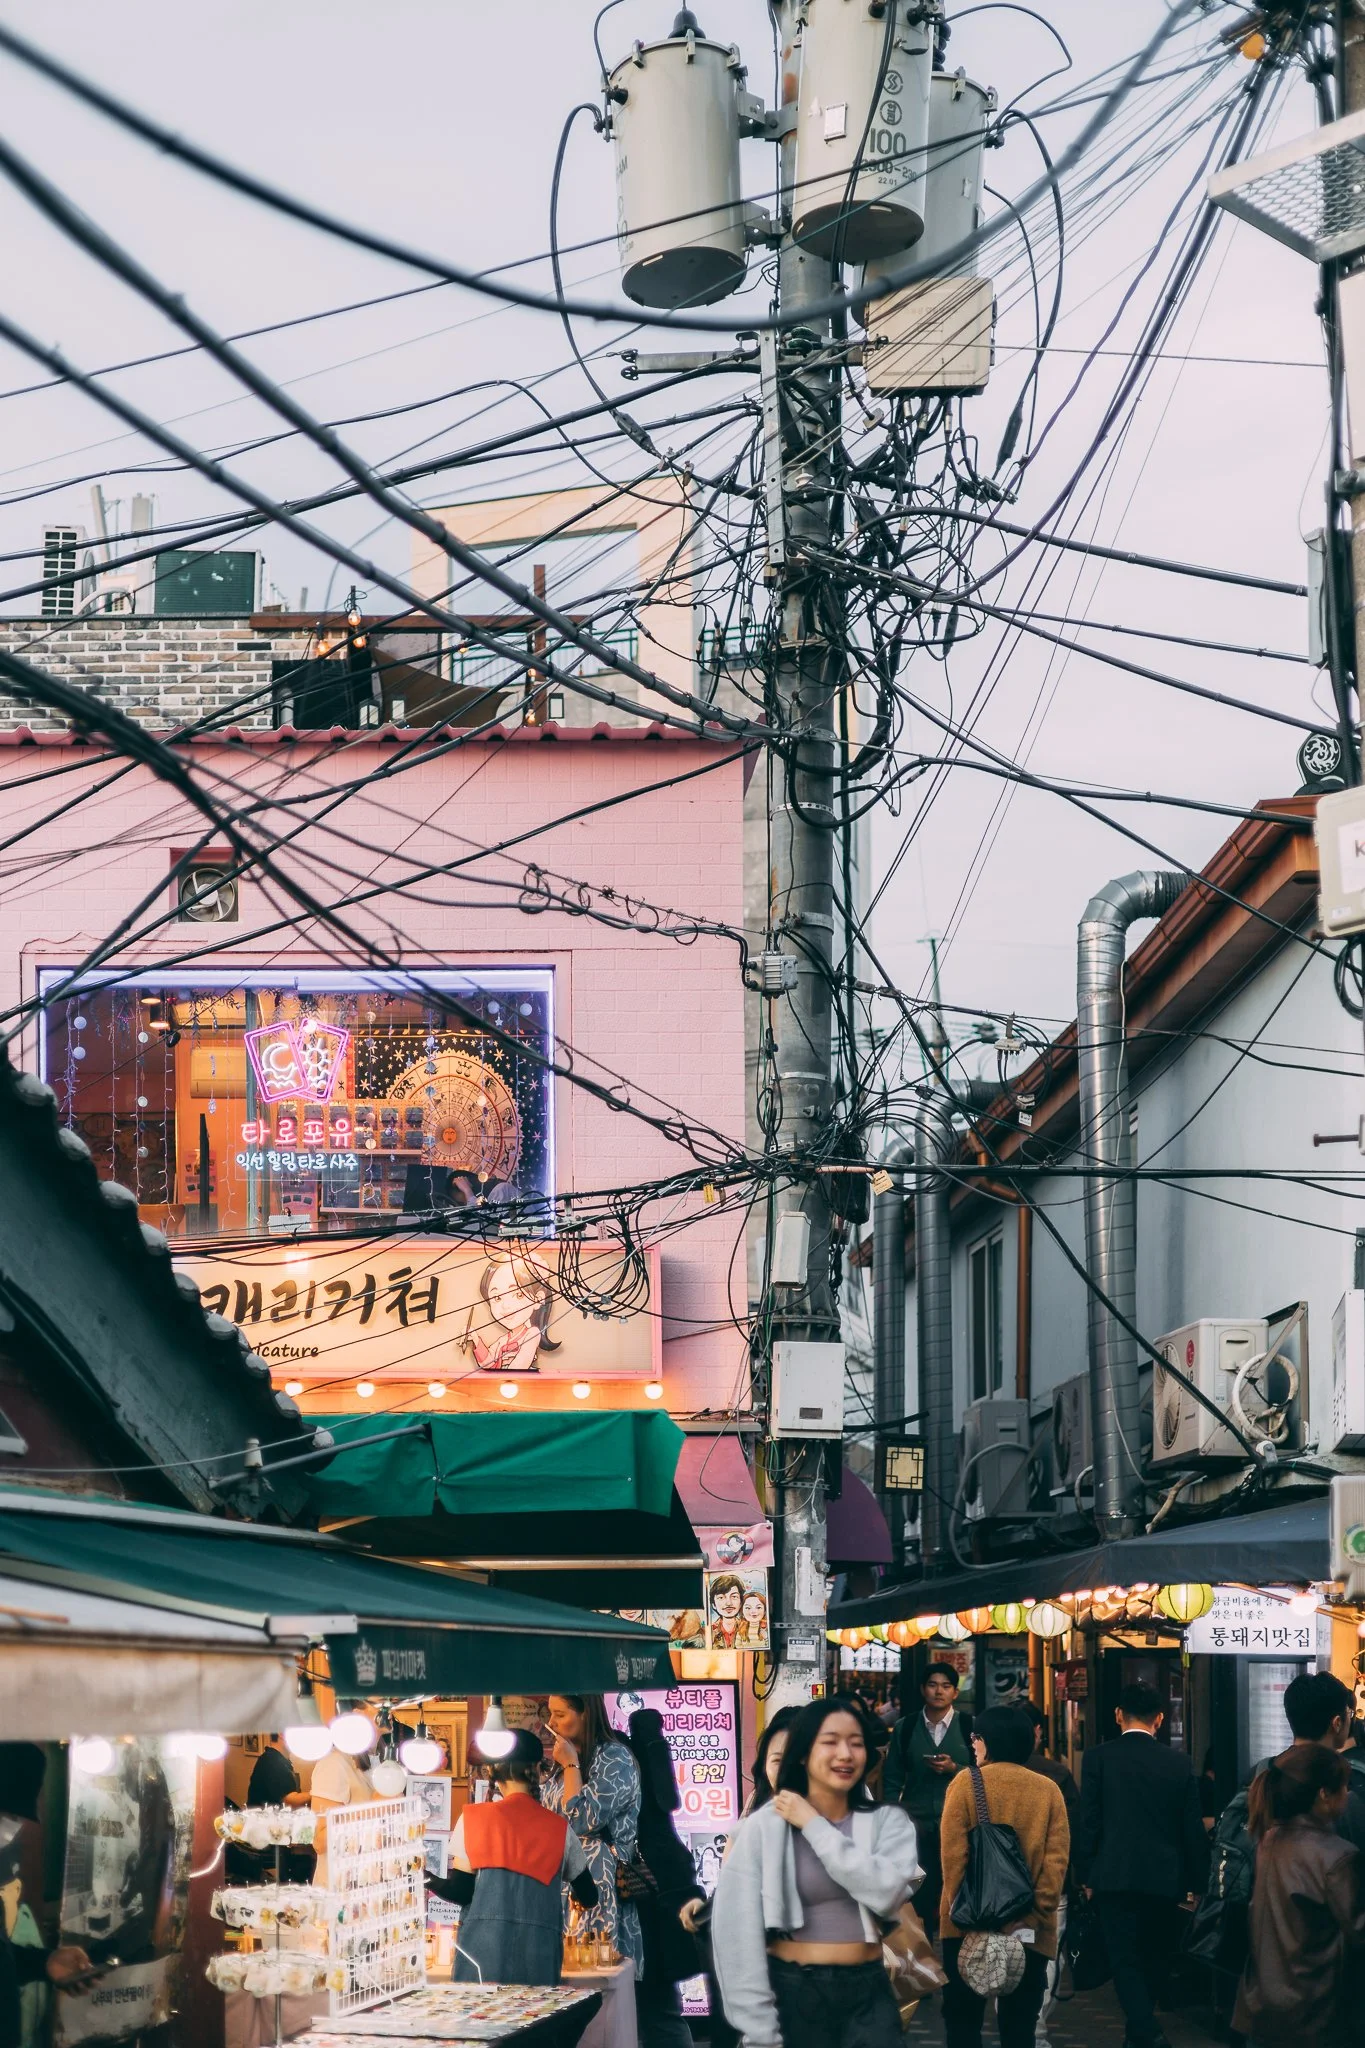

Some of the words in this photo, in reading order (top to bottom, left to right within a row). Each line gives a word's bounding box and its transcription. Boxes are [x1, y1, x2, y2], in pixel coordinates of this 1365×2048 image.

[869, 128, 906, 155] 100
[240, 1119, 352, 1147] 타로포유
[235, 1152, 263, 1171] 익선
[329, 1153, 359, 1171] 사주
[200, 1266, 440, 1326] 캐리커쳐
[1209, 1626, 1311, 1648] 통돼지맛집
[664, 1688, 723, 1710] 뷰티풀
[692, 1763, 726, 1784] 할인
